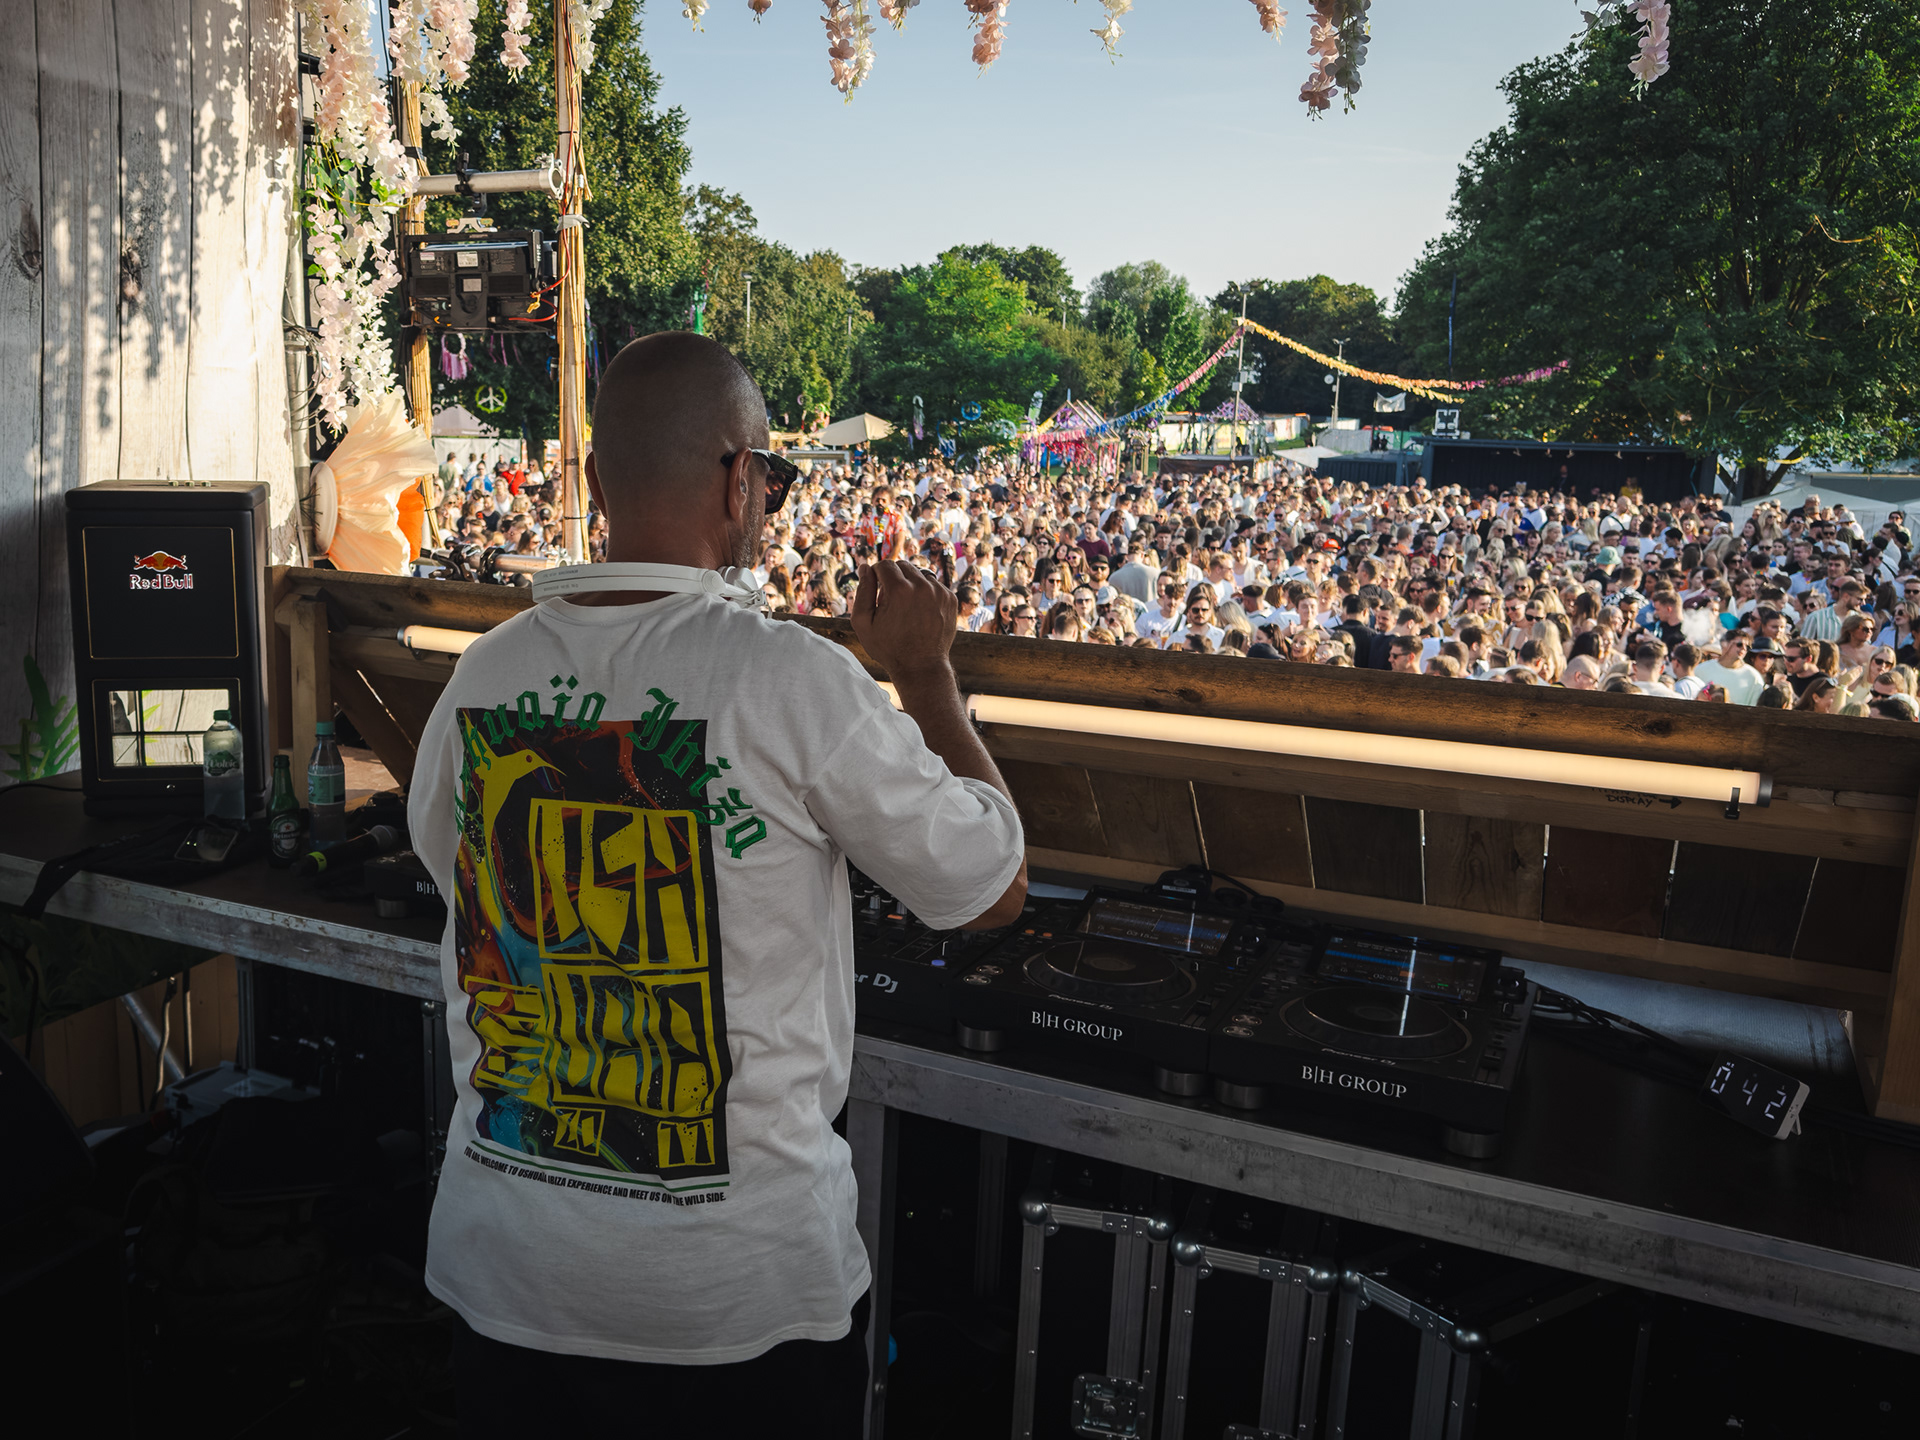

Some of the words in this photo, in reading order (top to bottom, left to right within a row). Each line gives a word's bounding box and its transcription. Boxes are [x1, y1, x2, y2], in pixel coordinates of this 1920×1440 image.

[129, 573, 161, 590] Red
[162, 573, 194, 590] Bull
[624, 687, 768, 860] Ibiza
[1605, 793, 1653, 808] DISPLAY
[1063, 1017, 1123, 1041] GROUP
[1338, 1073, 1407, 1099] GROUP
[464, 1145, 473, 1158] YOU
[471, 1149, 480, 1163] ARE
[480, 1154, 508, 1173] WELCOME
[508, 1165, 519, 1176] TO
[547, 1175, 566, 1187] IBIZA
[567, 1178, 612, 1196] EXPERIENCE
[612, 1187, 628, 1198] AND
[629, 1189, 650, 1201] MEET
[649, 1192, 660, 1202] US
[661, 1192, 672, 1204] ON
[672, 1195, 684, 1207] THE
[684, 1194, 705, 1206] WILD
